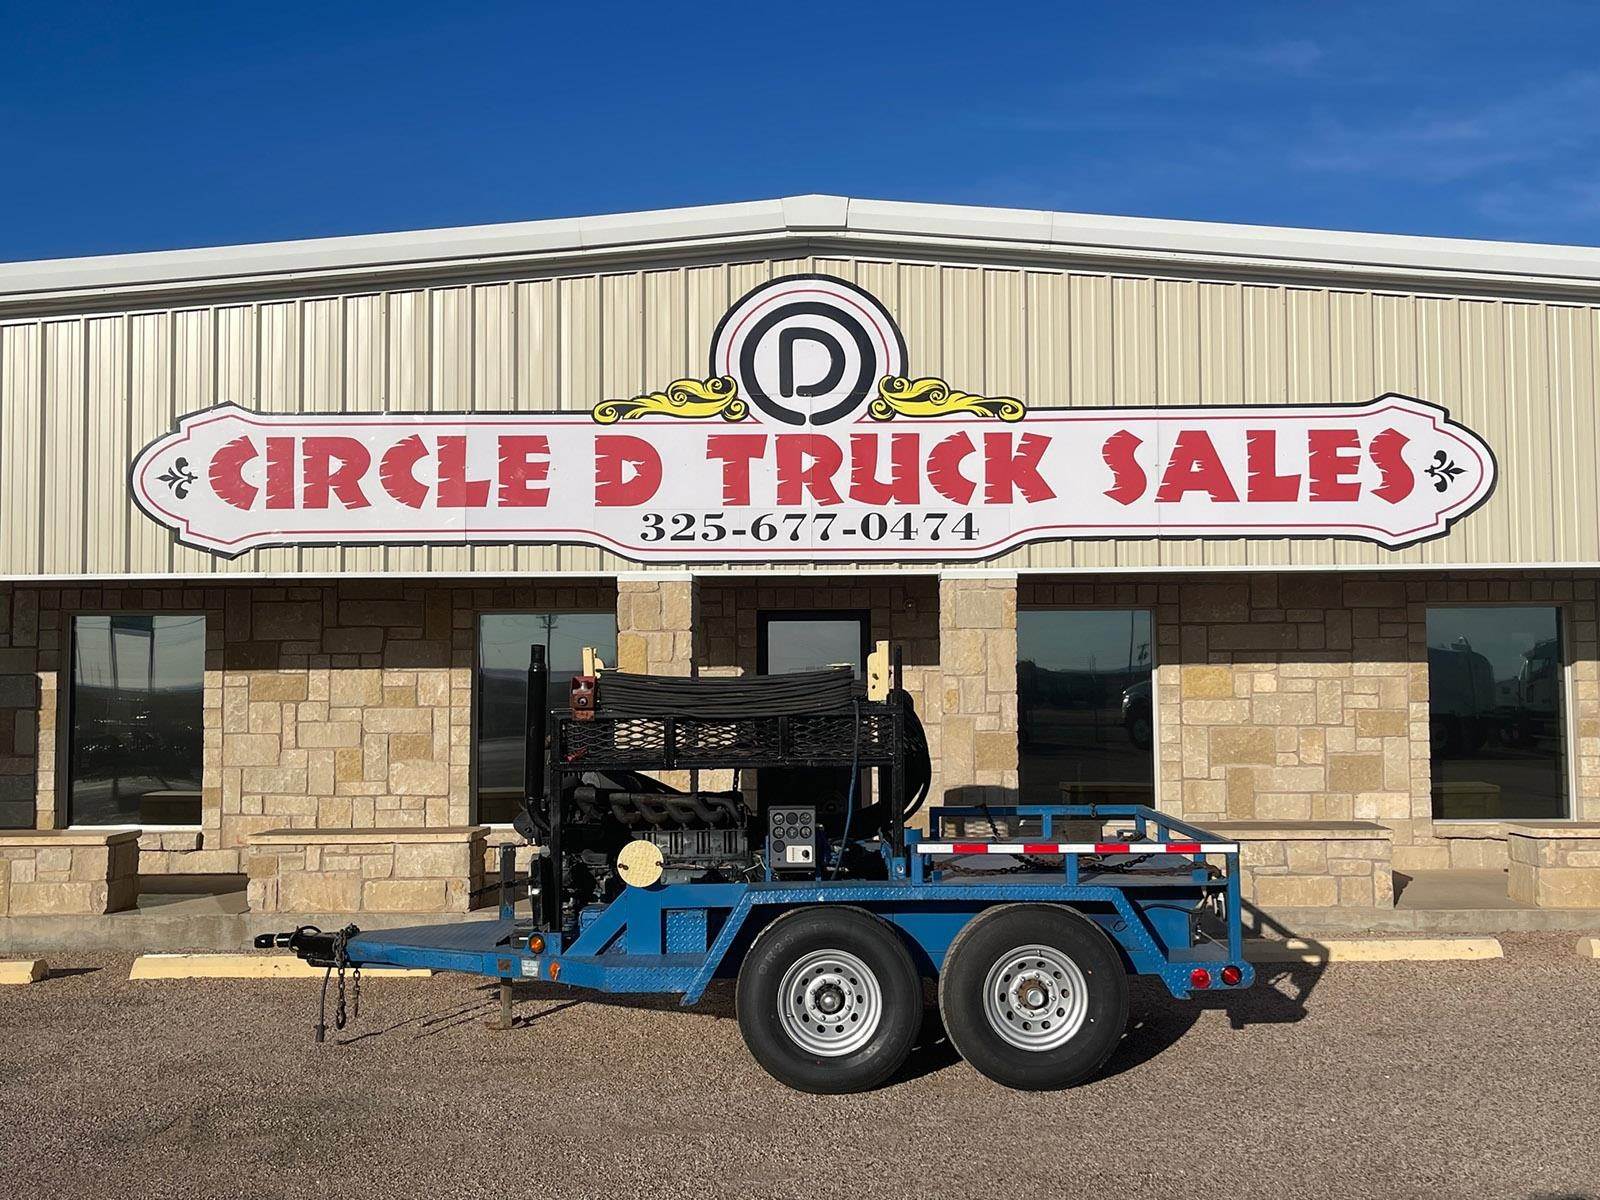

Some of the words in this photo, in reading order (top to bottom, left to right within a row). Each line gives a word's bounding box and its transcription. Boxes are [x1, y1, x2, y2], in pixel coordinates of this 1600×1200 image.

[779, 328, 846, 398] D
[209, 435, 550, 508] CIRCLE
[595, 435, 662, 507] D
[707, 432, 1055, 507] TRUCK
[1103, 430, 1415, 505] SALES
[641, 512, 980, 542] 325-677-0474
